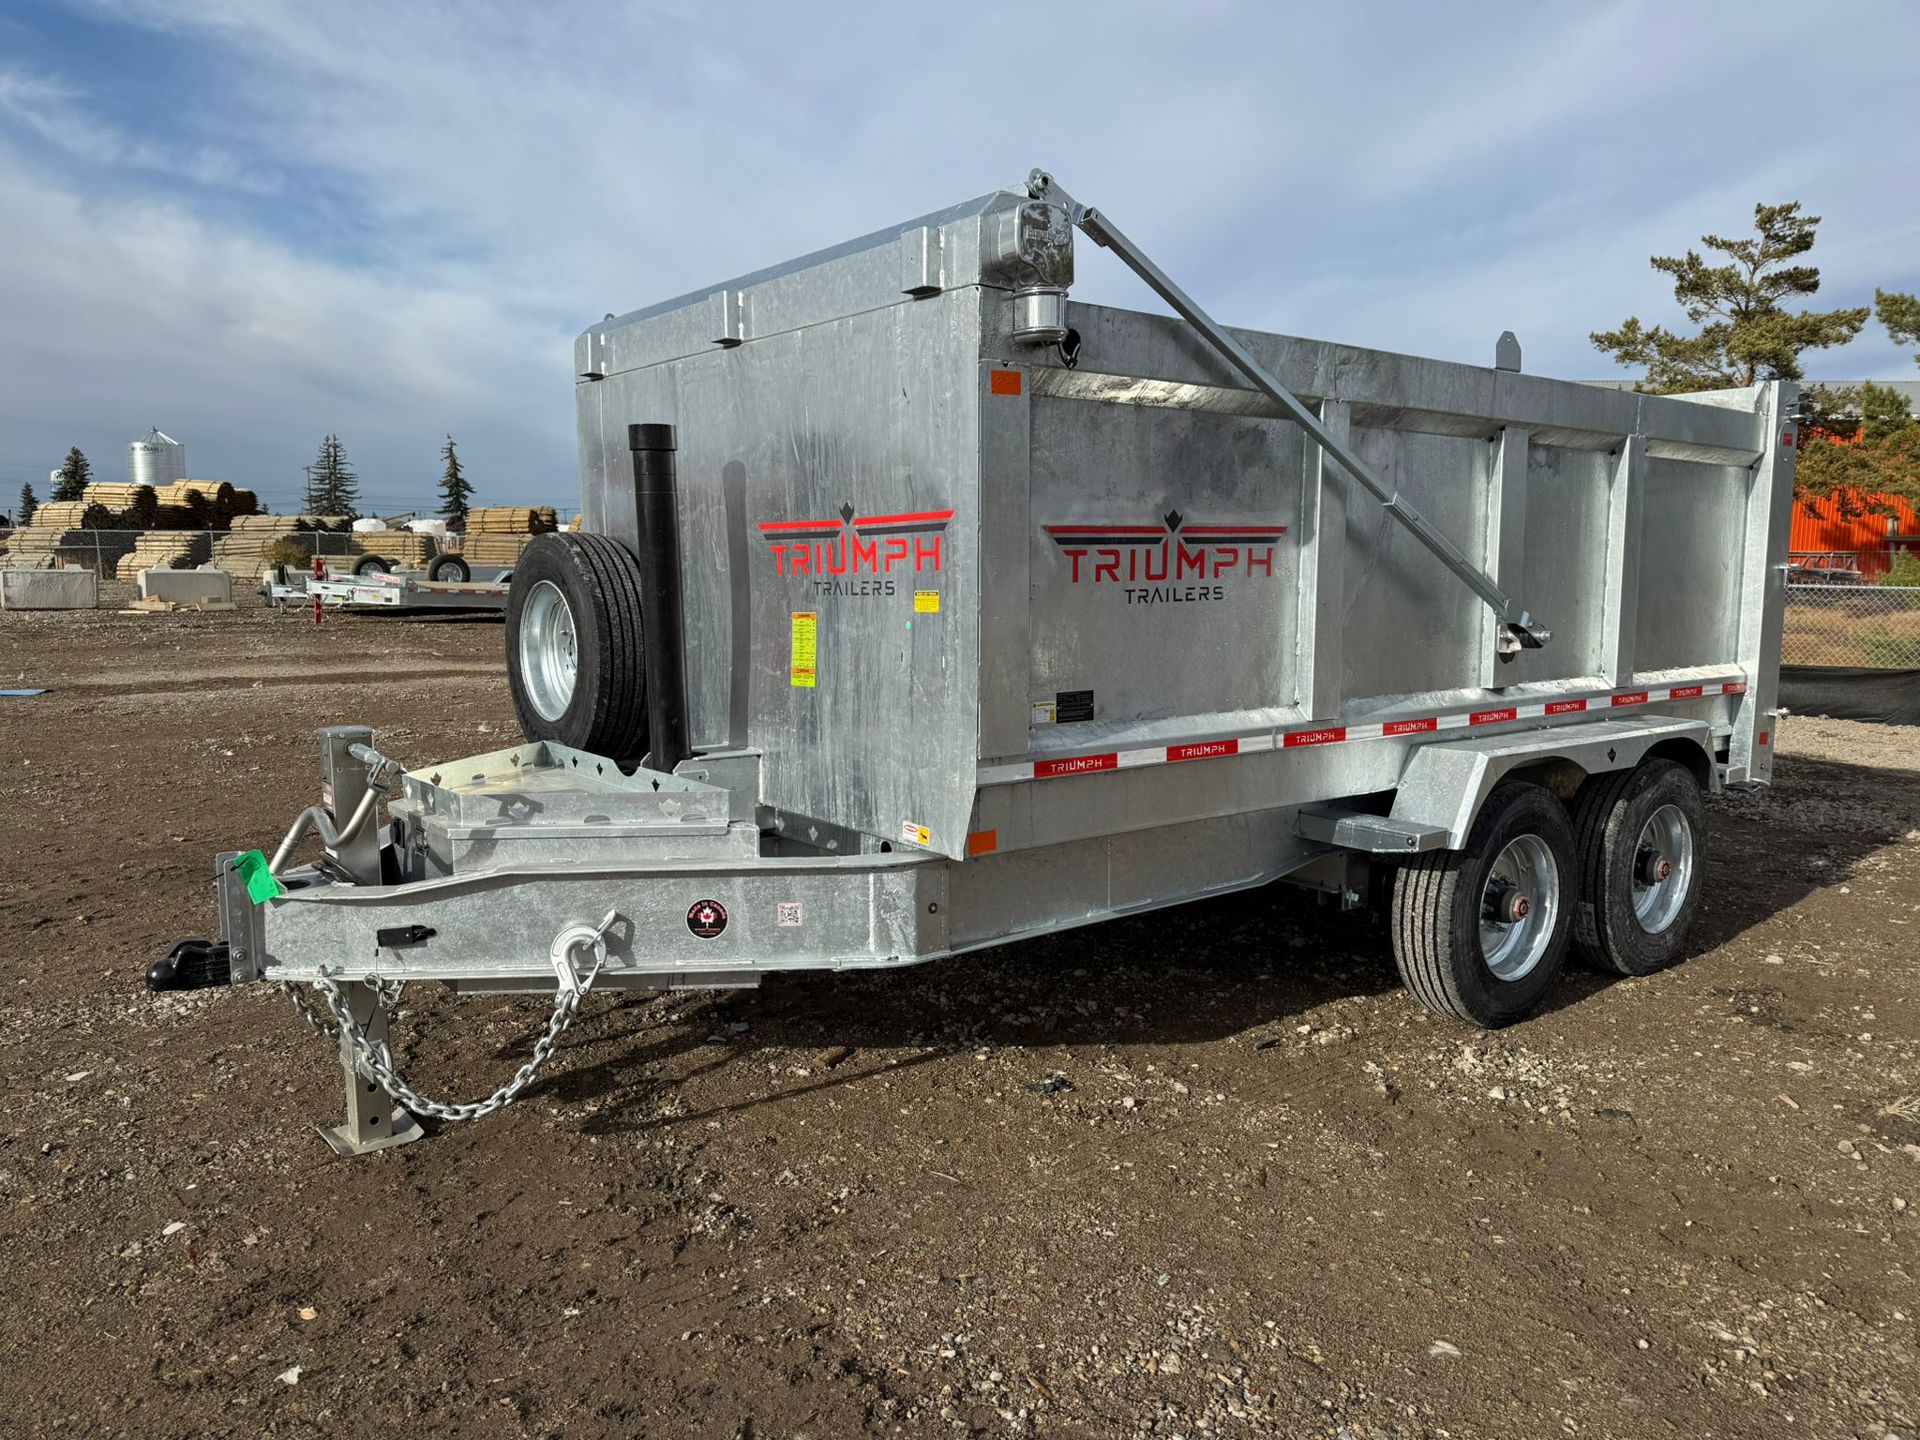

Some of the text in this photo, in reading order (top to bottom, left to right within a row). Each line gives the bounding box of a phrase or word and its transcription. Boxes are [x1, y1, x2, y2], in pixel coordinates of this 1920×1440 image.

[770, 532, 941, 577] TRIUMPH
[1063, 538, 1275, 583] TRIUMPH
[813, 580, 895, 596] TRAILERS
[1124, 586, 1224, 604] TRAILERS
[1552, 703, 1580, 712] TRIUMPH
[1478, 711, 1509, 722] TRIUMPH
[1393, 721, 1428, 734] TRIUMPH
[1295, 731, 1335, 744] TRIUMPH
[1180, 744, 1225, 757] TRIUMPH
[1050, 758, 1103, 773] TRIUMPH
